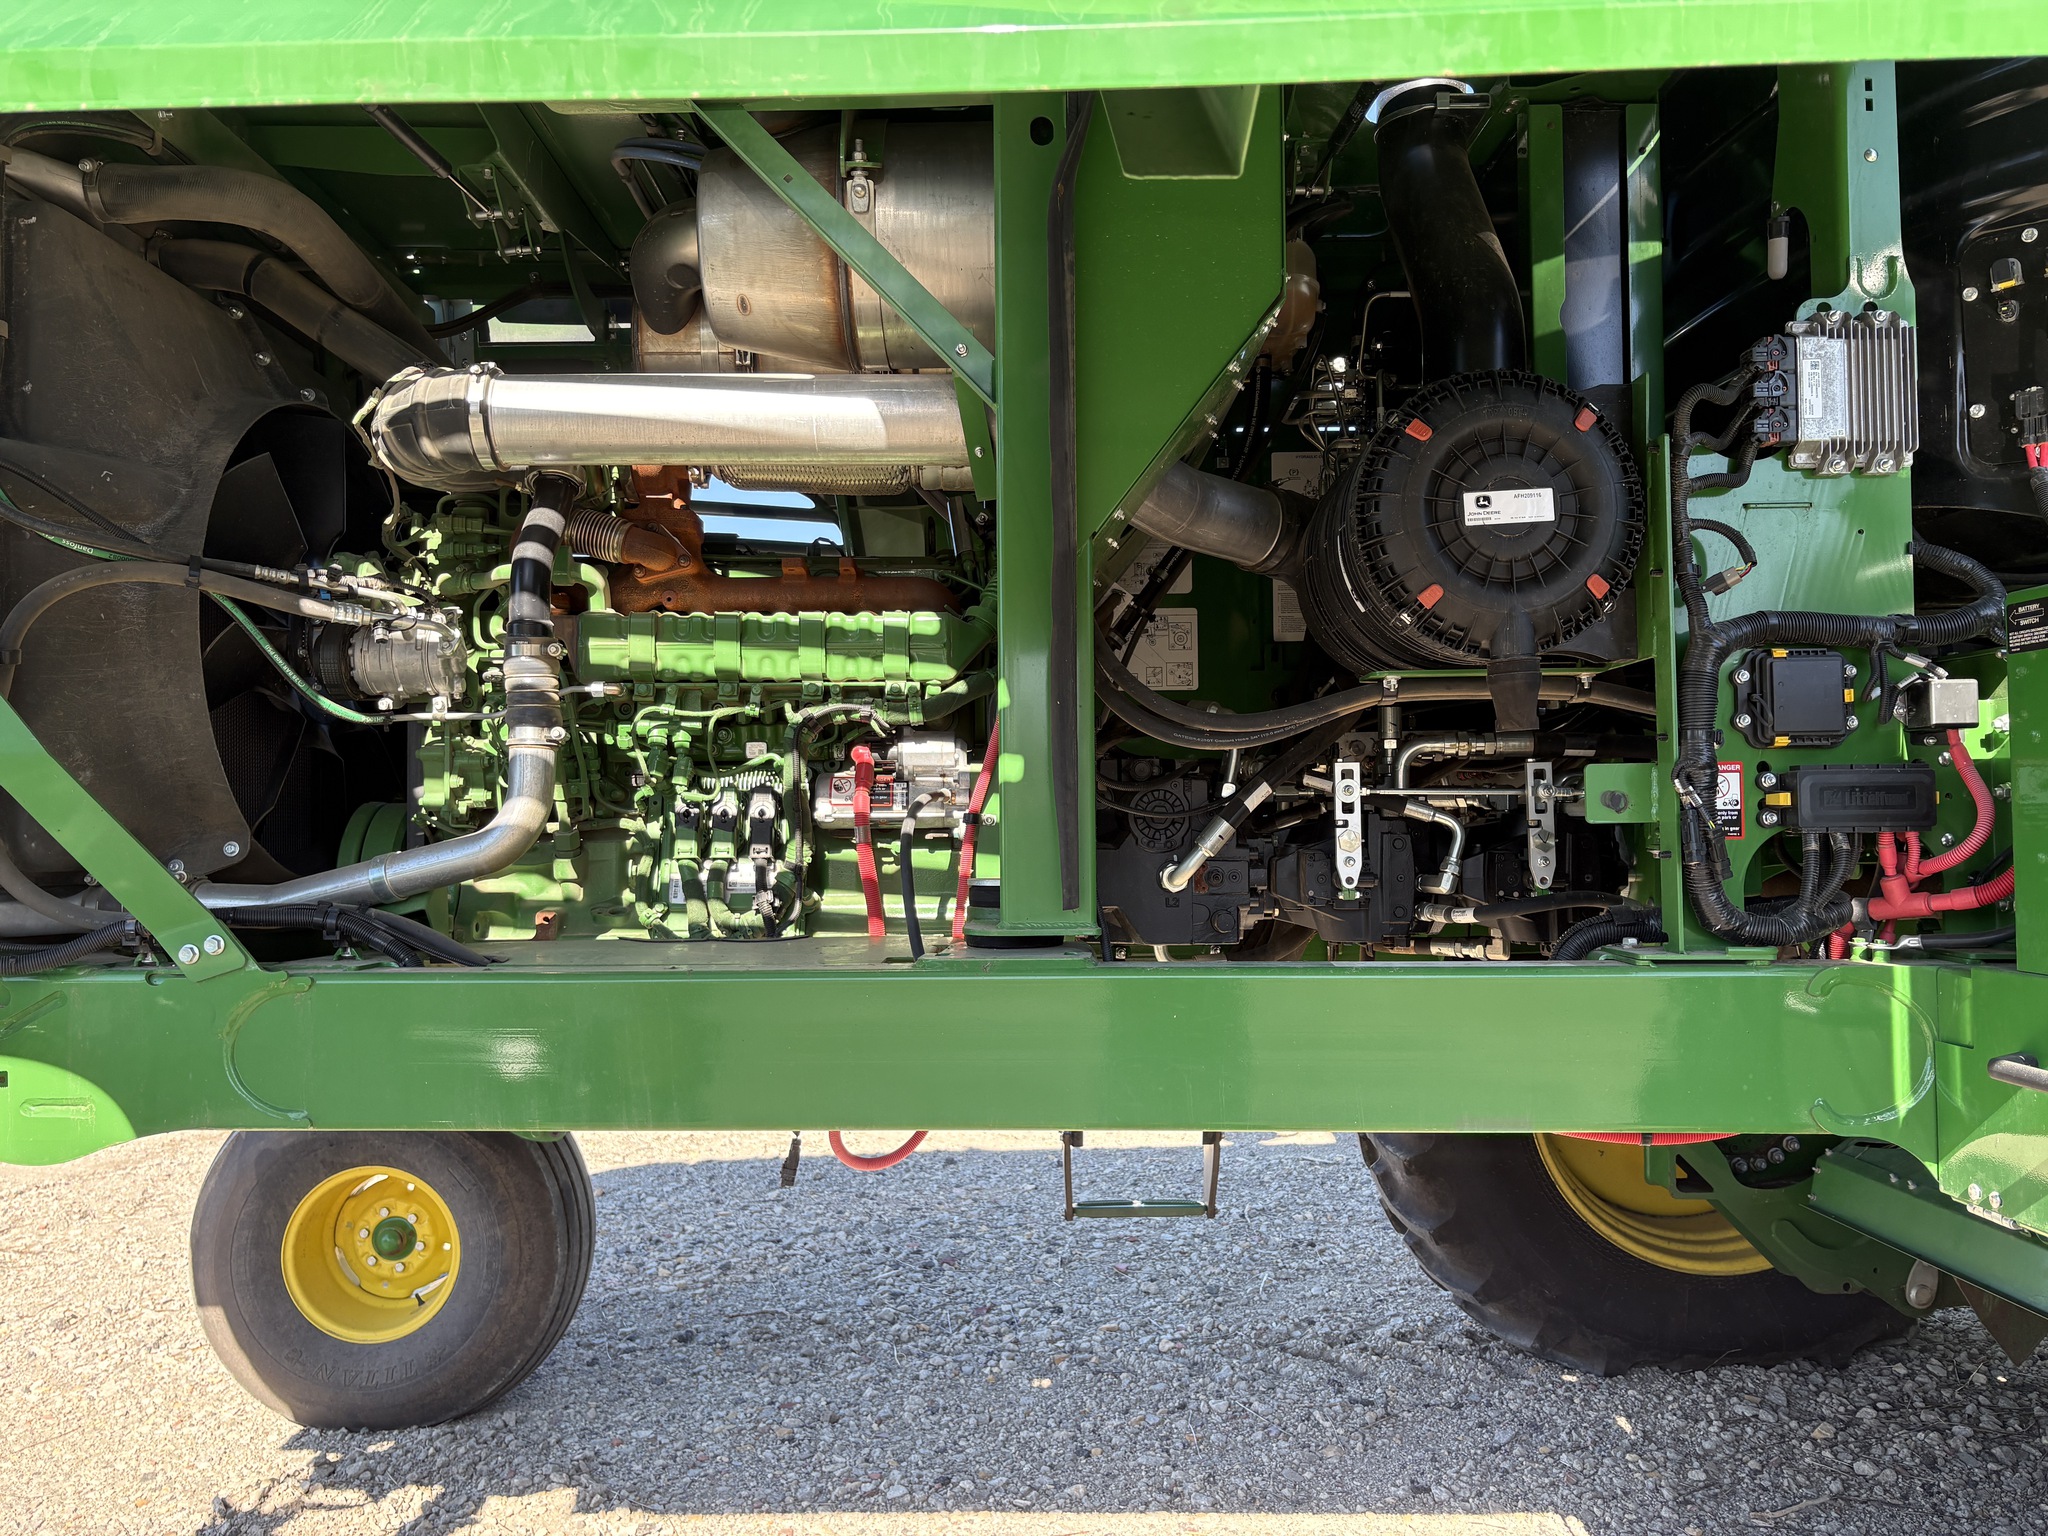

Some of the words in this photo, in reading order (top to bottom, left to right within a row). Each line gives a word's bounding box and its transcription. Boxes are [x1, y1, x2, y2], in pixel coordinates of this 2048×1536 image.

[60, 538, 94, 554] Danfoss
[2018, 603, 2040, 613] BATTERY
[2020, 617, 2039, 626] SWITCH
[1165, 897, 1180, 908] L2
[311, 1359, 418, 1390] TITAN
